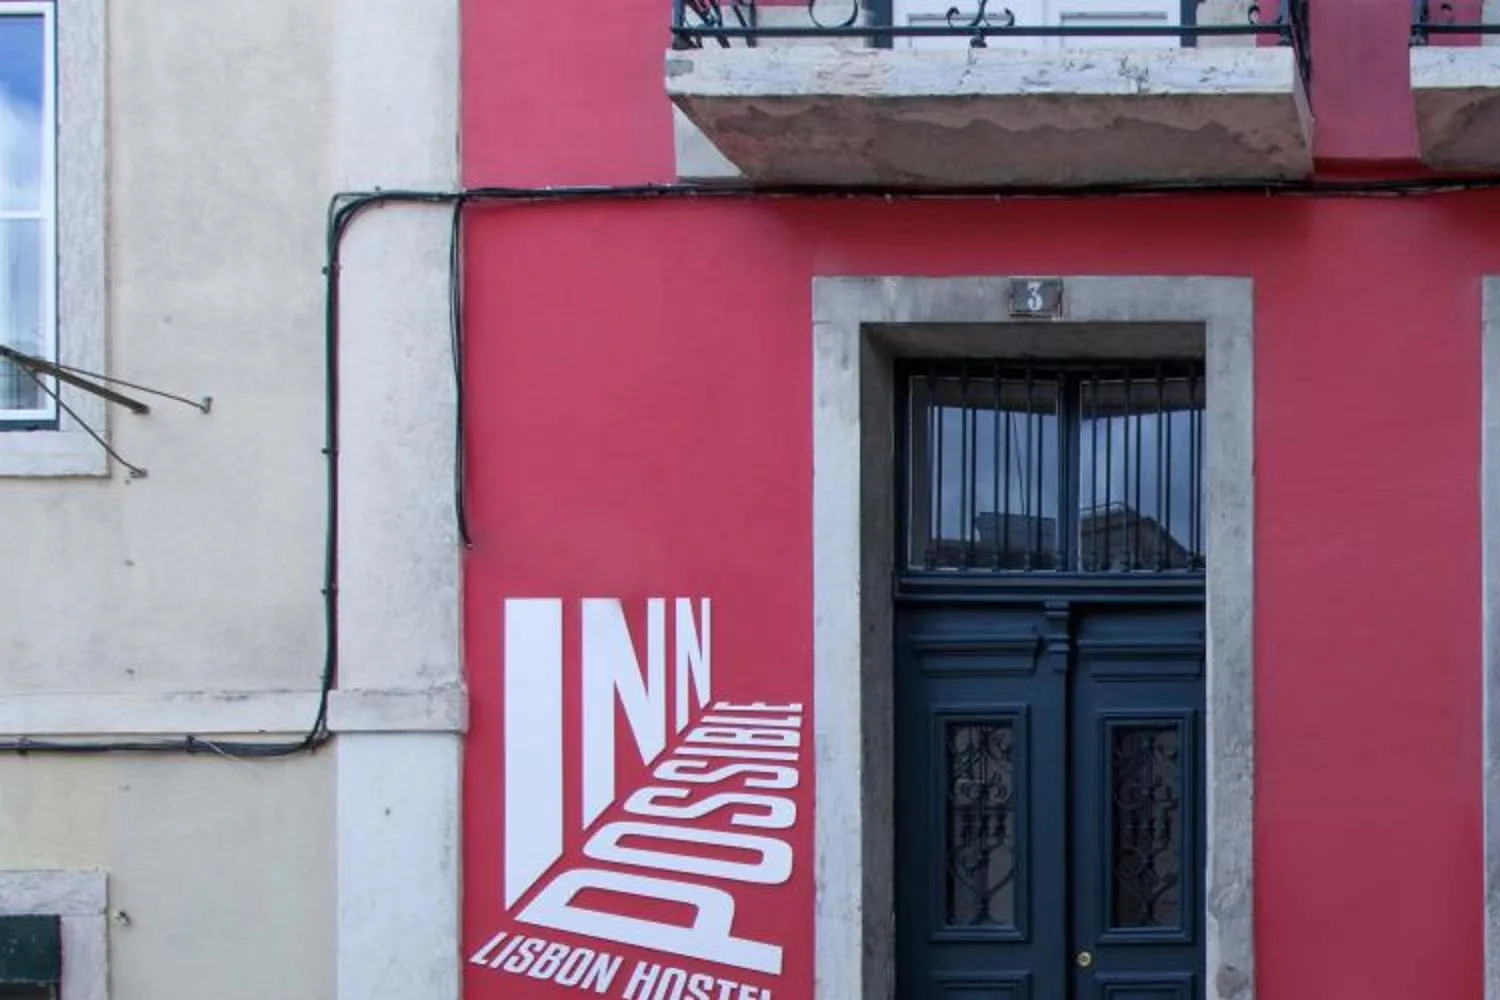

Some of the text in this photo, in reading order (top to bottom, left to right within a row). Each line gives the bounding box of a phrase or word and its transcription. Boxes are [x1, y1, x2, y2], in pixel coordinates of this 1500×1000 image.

[1027, 280, 1043, 311] 3
[503, 597, 711, 911] INN
[514, 701, 803, 975] POSSIBLE
[470, 931, 622, 992] LISBON
